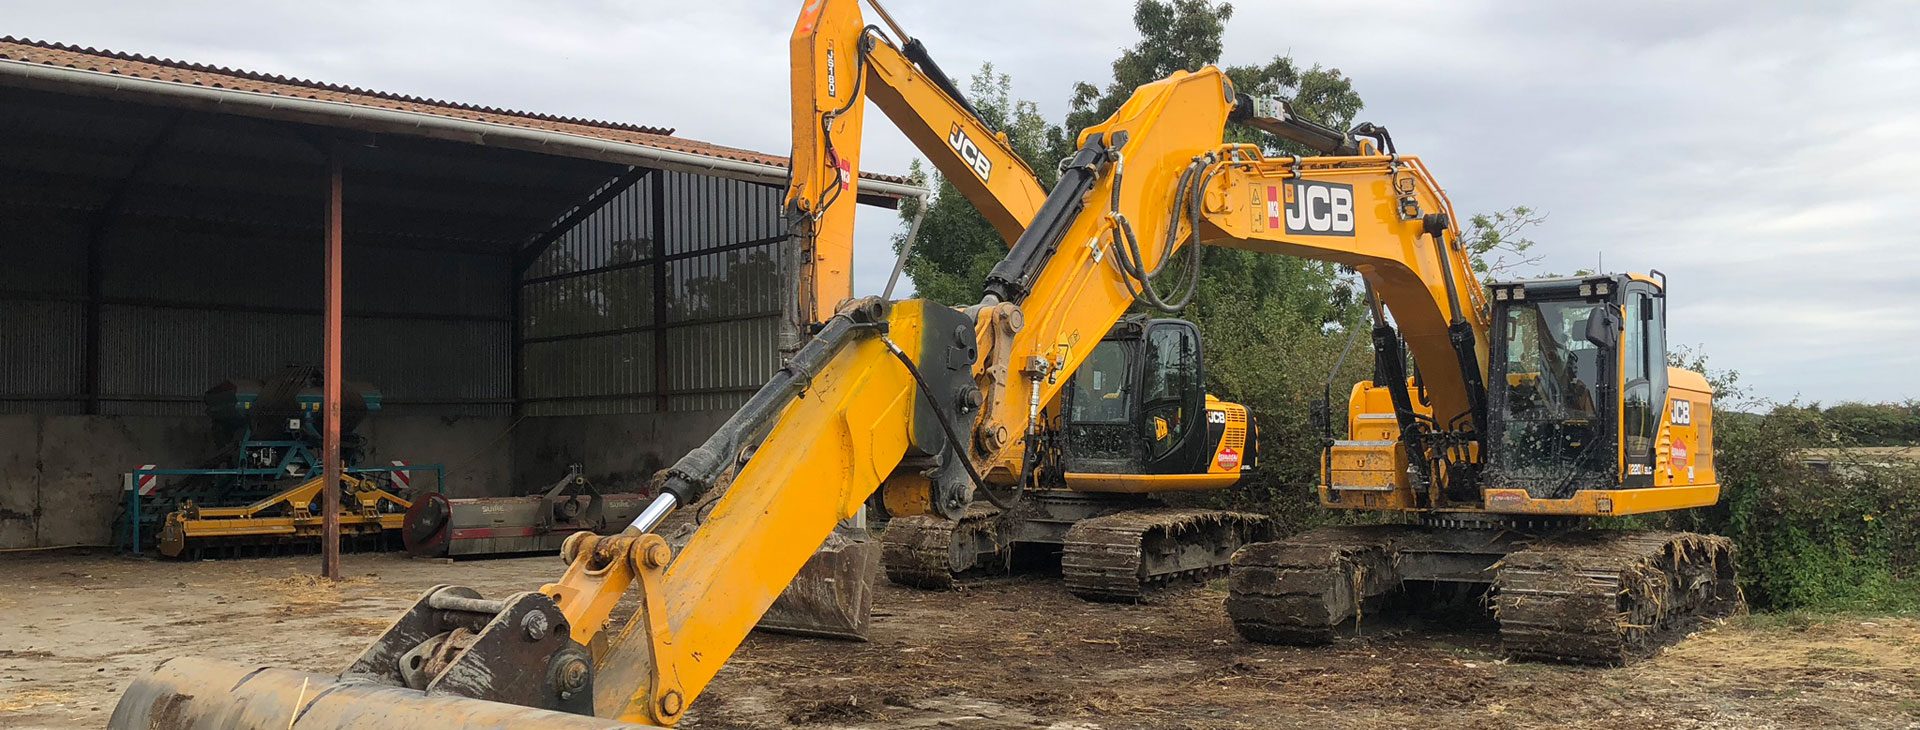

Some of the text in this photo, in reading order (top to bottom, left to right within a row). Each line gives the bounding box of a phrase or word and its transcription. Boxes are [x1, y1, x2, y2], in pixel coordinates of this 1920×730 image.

[949, 131, 991, 181] JCB
[1267, 200, 1279, 218] M3
[1286, 184, 1354, 232] JCB
[1208, 411, 1225, 423] JCB
[1671, 400, 1689, 423] JCB
